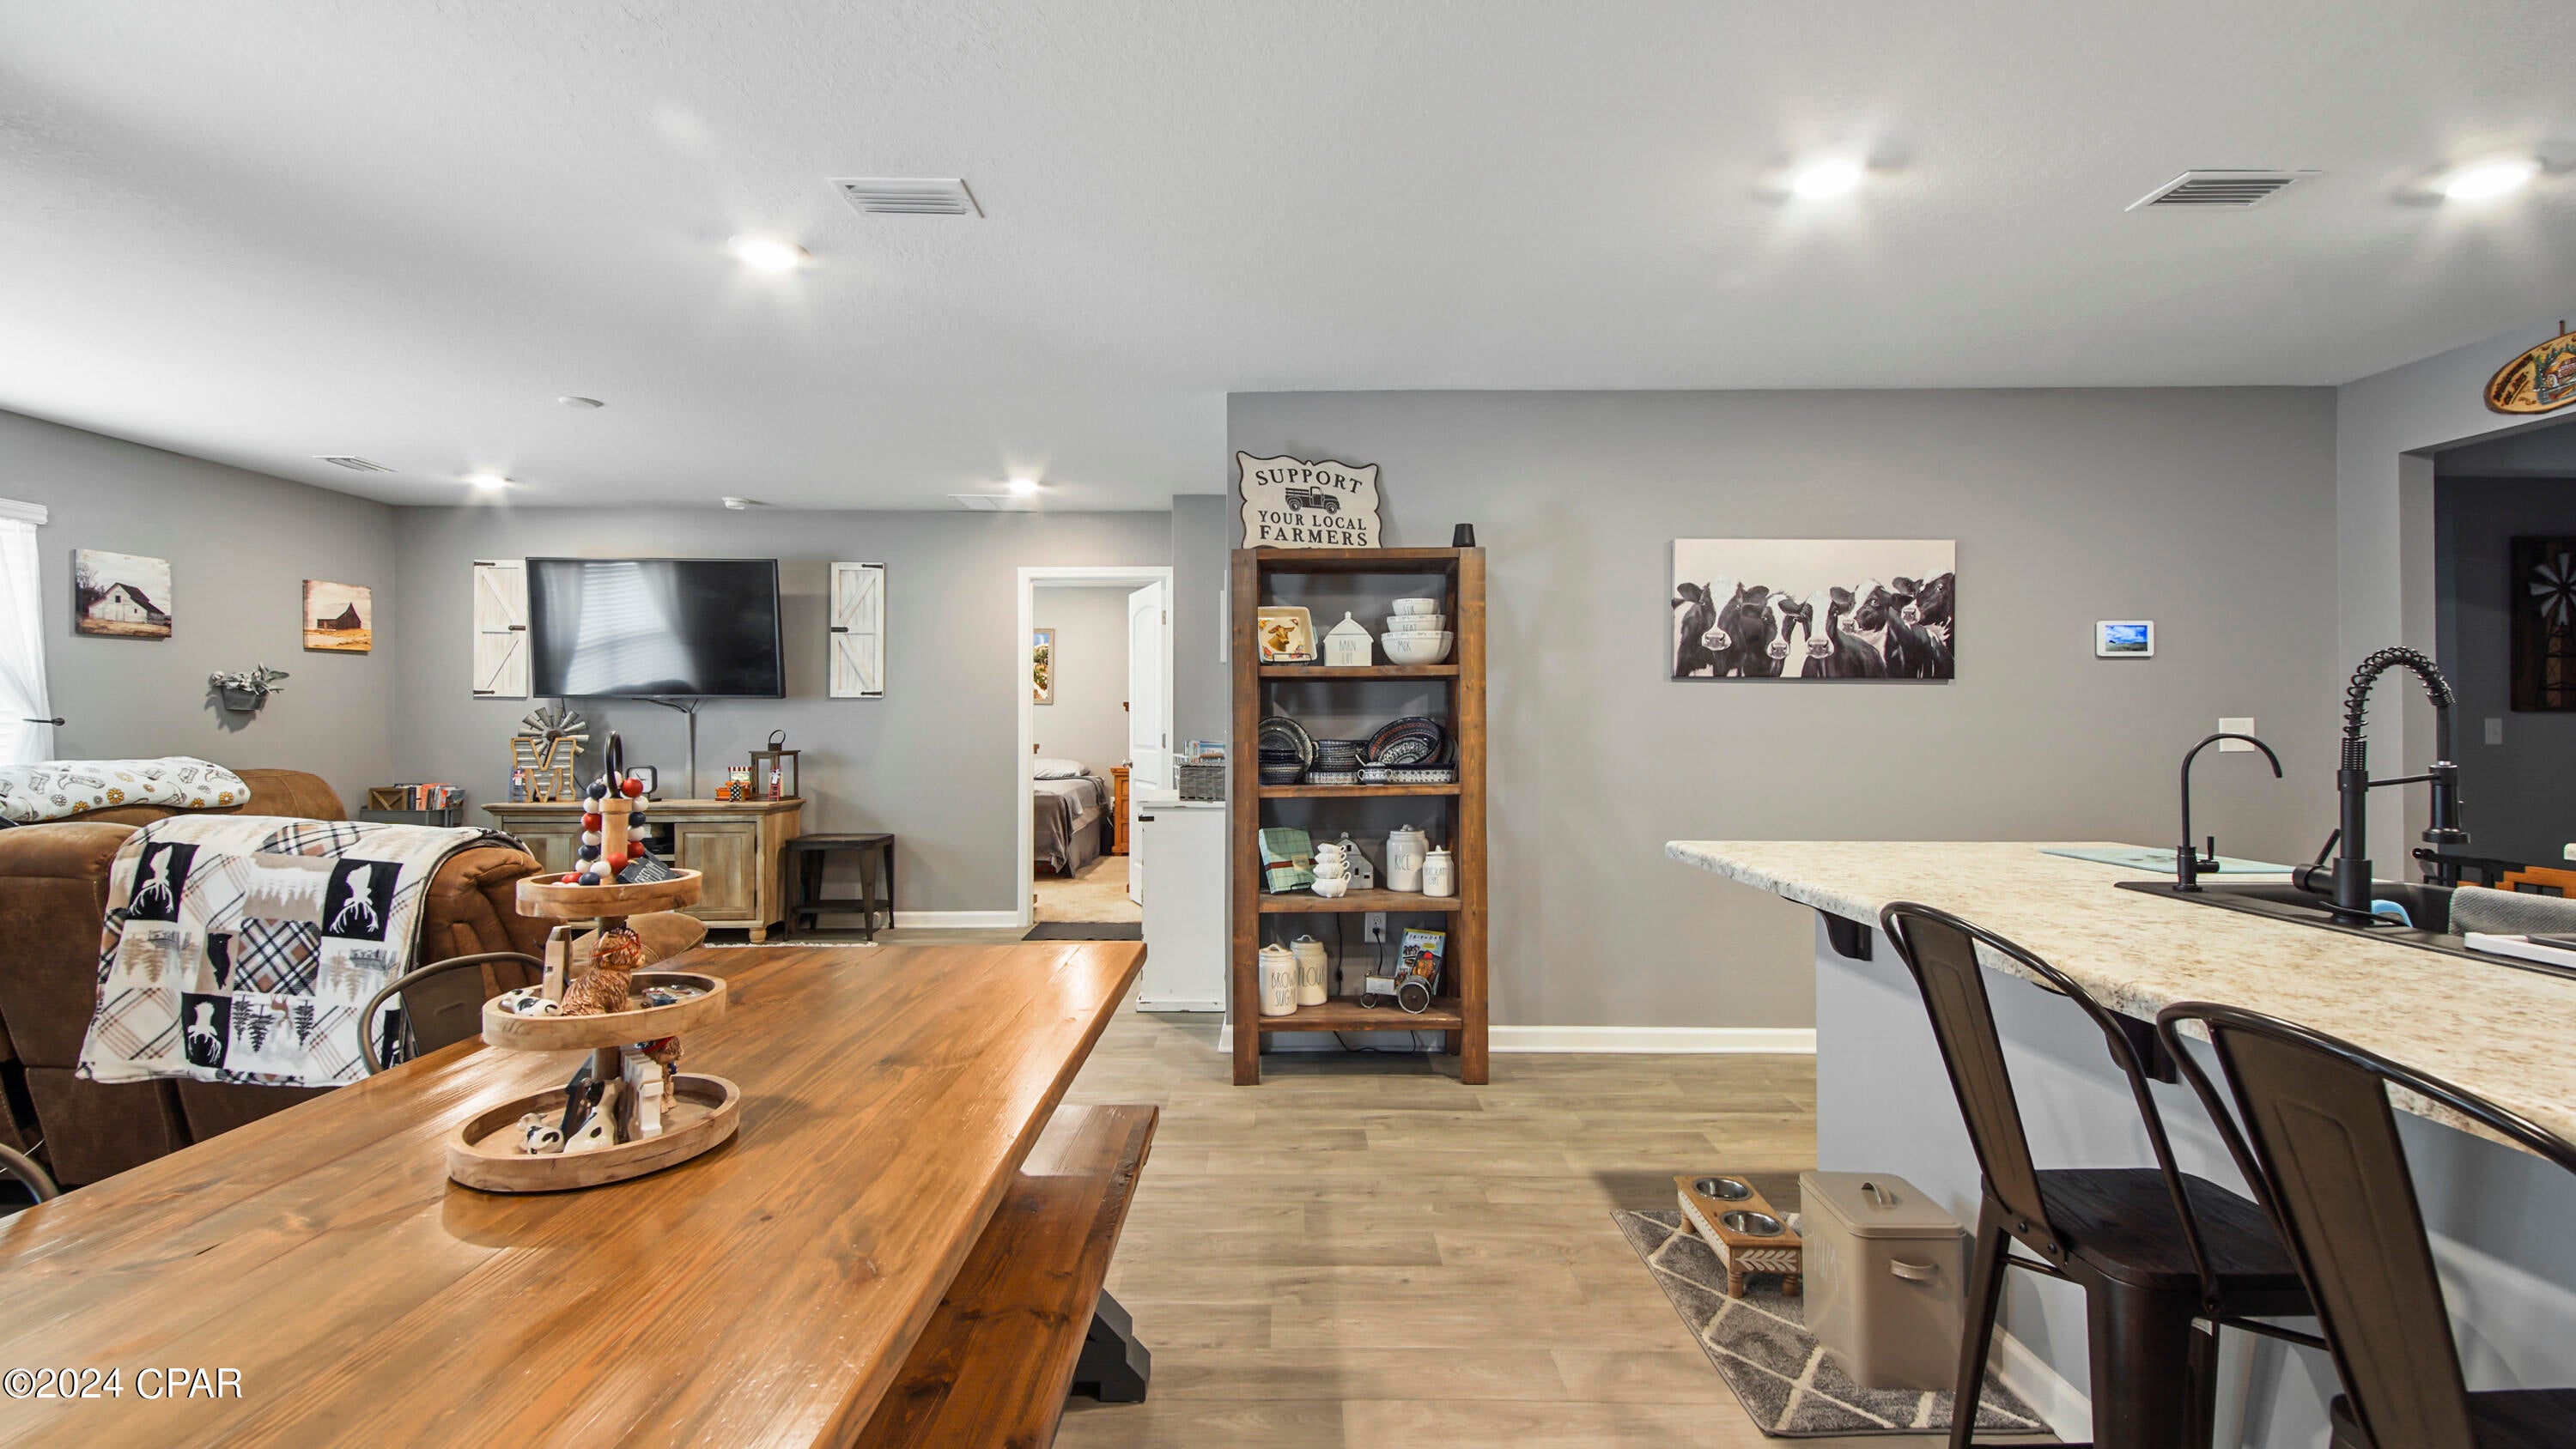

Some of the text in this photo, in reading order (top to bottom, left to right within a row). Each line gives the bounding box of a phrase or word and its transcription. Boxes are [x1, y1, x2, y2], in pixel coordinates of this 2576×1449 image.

[1255, 468, 1363, 494] SUPPORT
[1258, 510, 1367, 530] YOUR LOCAL
[1259, 524, 1368, 546] FARMERS
[1397, 640, 1412, 652] MIX
[510, 737, 576, 803] M
[1394, 854, 1411, 870] RICE
[1271, 970, 1297, 989] BROW
[1297, 964, 1326, 987] FLOUR
